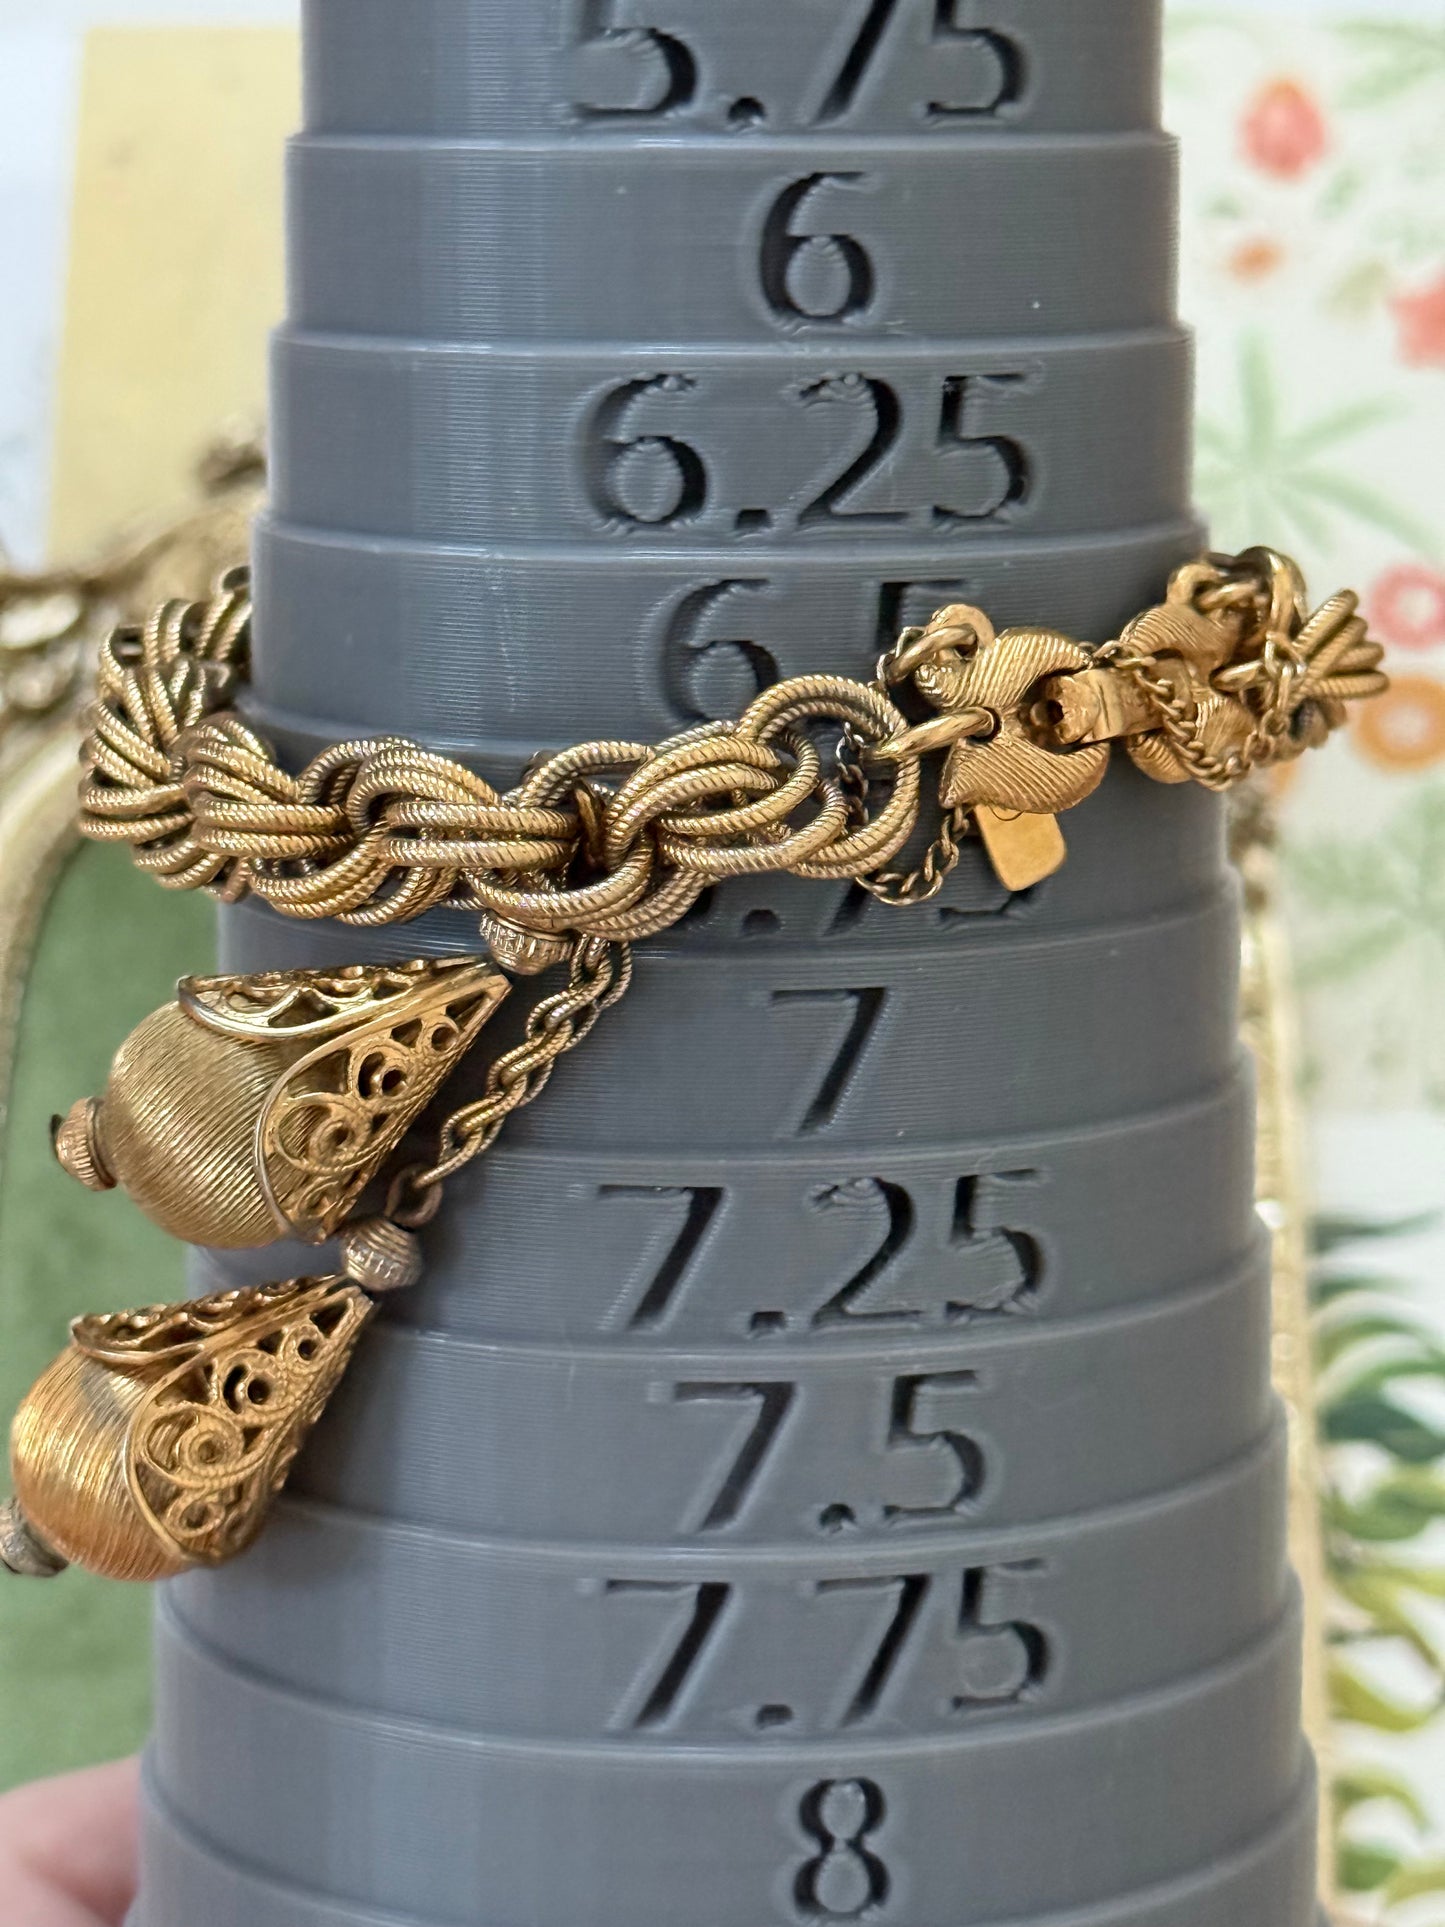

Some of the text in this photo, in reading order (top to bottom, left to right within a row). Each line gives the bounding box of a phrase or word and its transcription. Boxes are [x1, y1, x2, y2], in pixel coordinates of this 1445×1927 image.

[758, 171, 876, 320] 6
[582, 372, 1030, 529] 6.25
[771, 986, 887, 1136] 7
[598, 1168, 1046, 1330] 7.25
[670, 1370, 986, 1532] 7.5
[604, 1558, 1052, 1728] 7.75
[794, 1778, 890, 1917] 8
